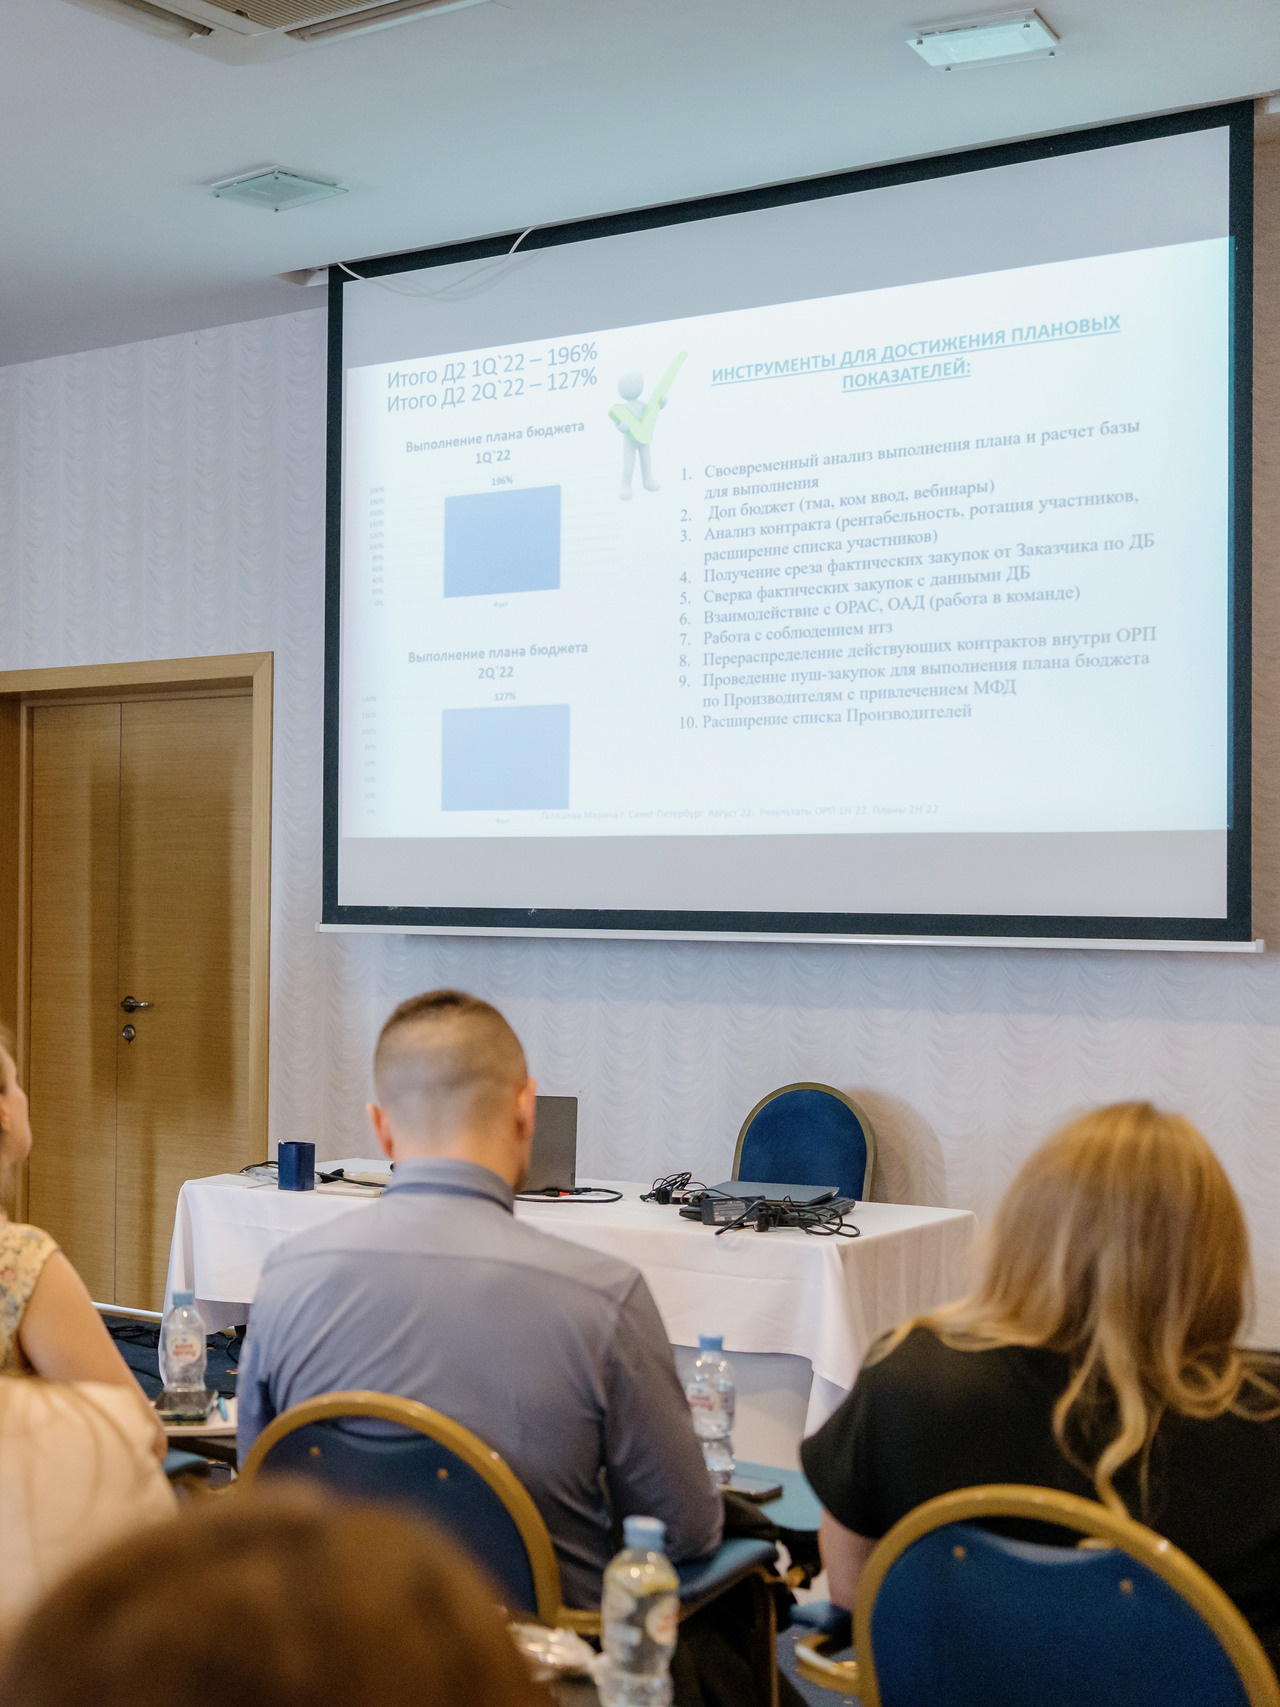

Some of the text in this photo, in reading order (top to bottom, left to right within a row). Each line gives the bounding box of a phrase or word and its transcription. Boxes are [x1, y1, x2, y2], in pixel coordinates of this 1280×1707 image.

[388, 370, 437, 389] Итого
[441, 362, 466, 385] Д2
[548, 342, 598, 366] 196%
[712, 314, 1121, 385] ИНСТРУМЕНТЫ ДЛЯ ДОСТИЖЕНИЯ ПЛАНОВЫХ
[388, 394, 437, 413] Итого
[441, 386, 465, 409] Д2
[548, 367, 597, 391] 127%
[842, 357, 971, 392] ПОКАЗАТЕЛЕЙ:
[406, 423, 584, 453] Выполнение плана бюджета
[683, 421, 1140, 480] 1. Своевременный анализ выполнения плана и расчет базы
[492, 476, 513, 486] 196%
[704, 478, 819, 500] для выполнения
[680, 509, 691, 522] 2.
[708, 505, 736, 521] Доп
[740, 502, 795, 516] бюджет
[840, 495, 866, 507] ком
[871, 491, 909, 504] ввод,
[914, 479, 995, 499] вебинары)
[681, 492, 1138, 542] 3. Анализ контракта (рентабельность, ротация участников,
[680, 533, 1154, 584] 4. Получение среза фактических закупок от Заказчика по ДБ
[704, 530, 938, 565] расширение списка участников)
[680, 592, 691, 605] 5.
[704, 590, 752, 605] Сверка
[757, 583, 849, 603] фактических
[854, 578, 913, 594] закупок
[930, 571, 1001, 587] данными
[1006, 565, 1030, 583] ДБ
[679, 613, 690, 625] 6.
[704, 606, 819, 624] Взаимодействие
[888, 595, 925, 611] ОАД
[929, 593, 988, 612] (работа
[1007, 586, 1080, 603] команде)
[408, 644, 588, 663] Выполнение плана бюджета
[679, 627, 1156, 669] 8. Перераспределение действующих контрактов внутри ОРП
[680, 633, 690, 645] 7.
[704, 630, 750, 645] Работа
[766, 625, 863, 640] соблюдением
[679, 653, 1149, 690] 9. Проведение пуш-закупок для выполнения плана бюджета
[494, 692, 516, 701] 127%
[703, 698, 719, 707] по
[724, 692, 842, 710] Производителям
[860, 686, 968, 703] привлечением
[974, 680, 1016, 695] МФД
[681, 704, 972, 730] 10. Расширение списка Производителей
